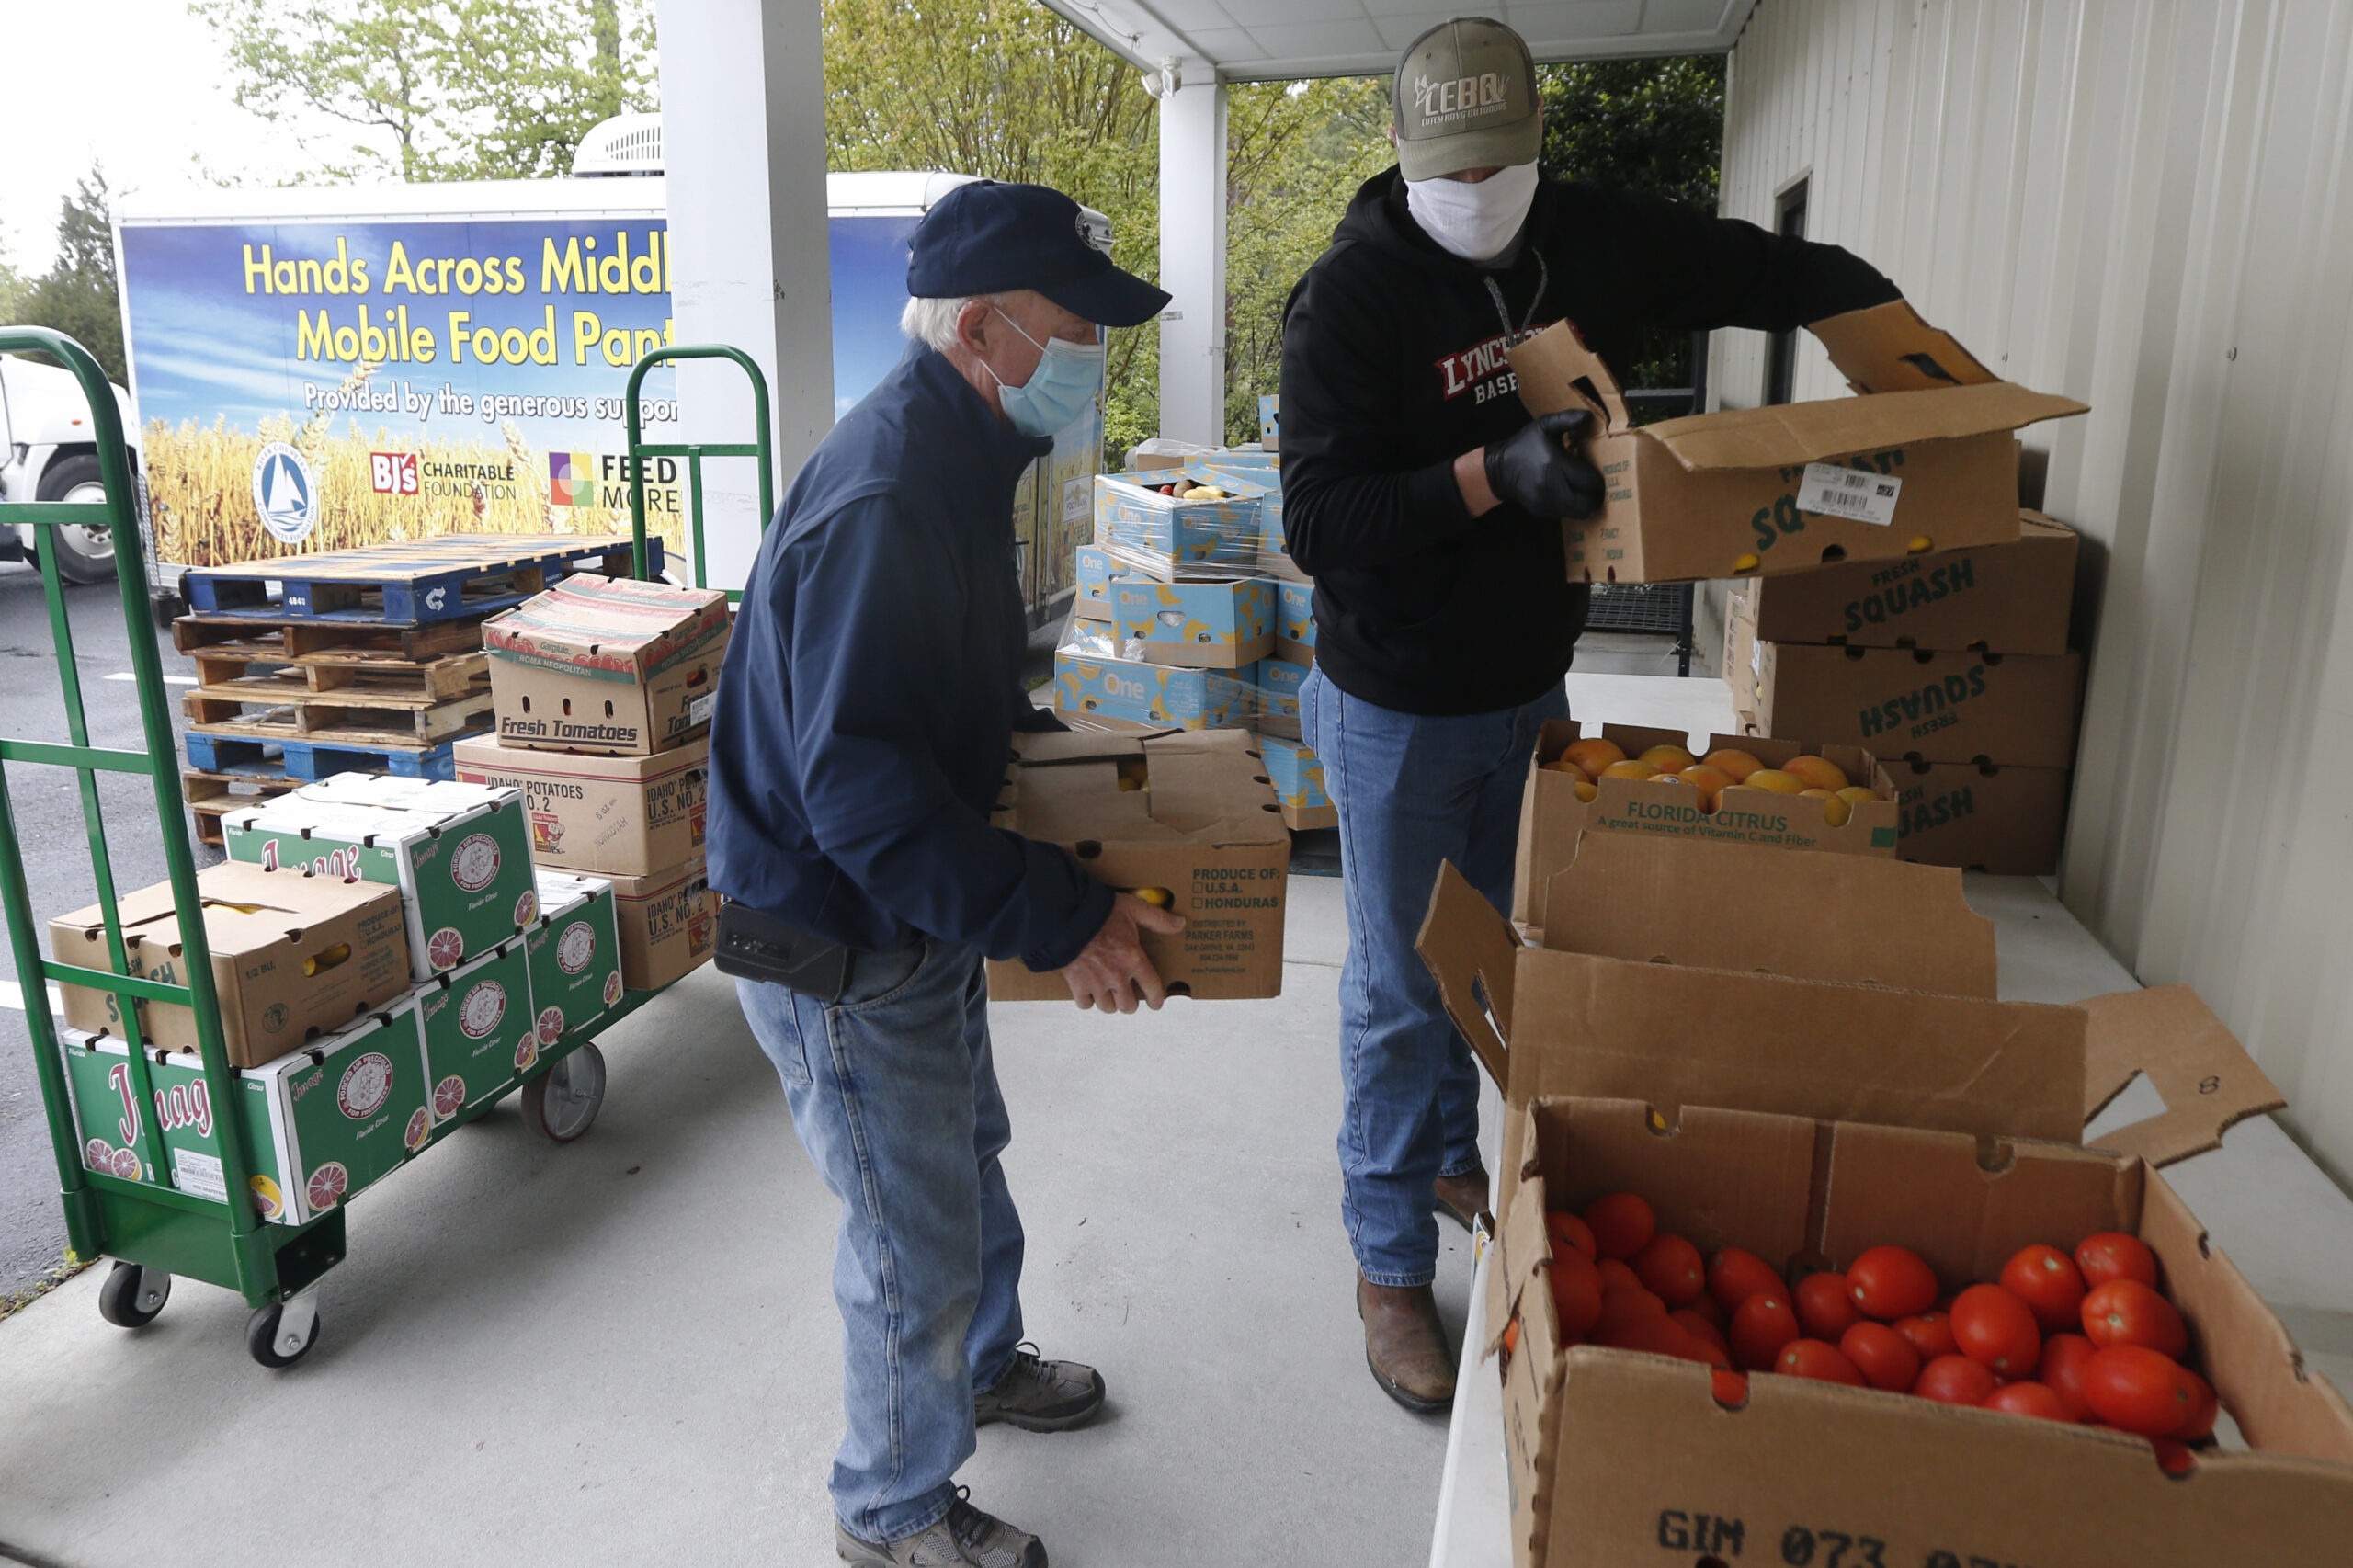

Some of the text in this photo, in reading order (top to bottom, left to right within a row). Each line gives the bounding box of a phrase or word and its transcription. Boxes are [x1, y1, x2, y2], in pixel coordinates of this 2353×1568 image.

[243, 235, 369, 295] Hands
[382, 240, 526, 295] Across
[296, 304, 437, 363] Mobile
[448, 304, 558, 365] Food
[303, 381, 399, 412] Provided
[404, 381, 434, 422] by
[438, 382, 474, 415] the
[479, 392, 588, 424] generous
[423, 462, 516, 481] CHARITABLE
[424, 481, 517, 500] FOUNDATION
[602, 486, 680, 513] MRE
[1082, 555, 1103, 570] One
[1871, 558, 1920, 586] FRESH
[1119, 590, 1148, 606] One
[1284, 588, 1306, 608] One
[1844, 558, 1975, 632] SQUASH
[518, 654, 592, 676] ROMA NEOPOLITAN
[1269, 667, 1300, 682] One
[1103, 672, 1145, 699] One
[1859, 665, 1986, 738] SQUASH
[501, 717, 638, 741] Fresh Tomatoes
[1911, 711, 1960, 739] FRESH
[527, 780, 584, 800] POTATOES
[646, 781, 675, 802] IDAHO
[648, 799, 674, 820] U.S.
[699, 786, 705, 801] 2
[1627, 801, 1788, 832] FLORIDA CITRUS
[1597, 815, 1817, 846] A great source of Vitamin C and Fiber
[453, 846, 464, 872] FORCED
[462, 838, 472, 848] AIR
[1192, 868, 1280, 880] PRODUCE OF:
[1205, 882, 1244, 893] U.S.A.
[647, 895, 674, 919] IDAHO
[1205, 897, 1279, 909] HONDURAS
[648, 914, 673, 936] U.S.
[698, 896, 704, 912] 2
[1186, 930, 1255, 940] PARKER FARMS
[247, 1082, 265, 1092] Citrus
[339, 1054, 392, 1101] FORCED AIR PRECOOLED
[347, 1085, 390, 1118] FOR FRESHNESS
[356, 1123, 375, 1141] Florida
